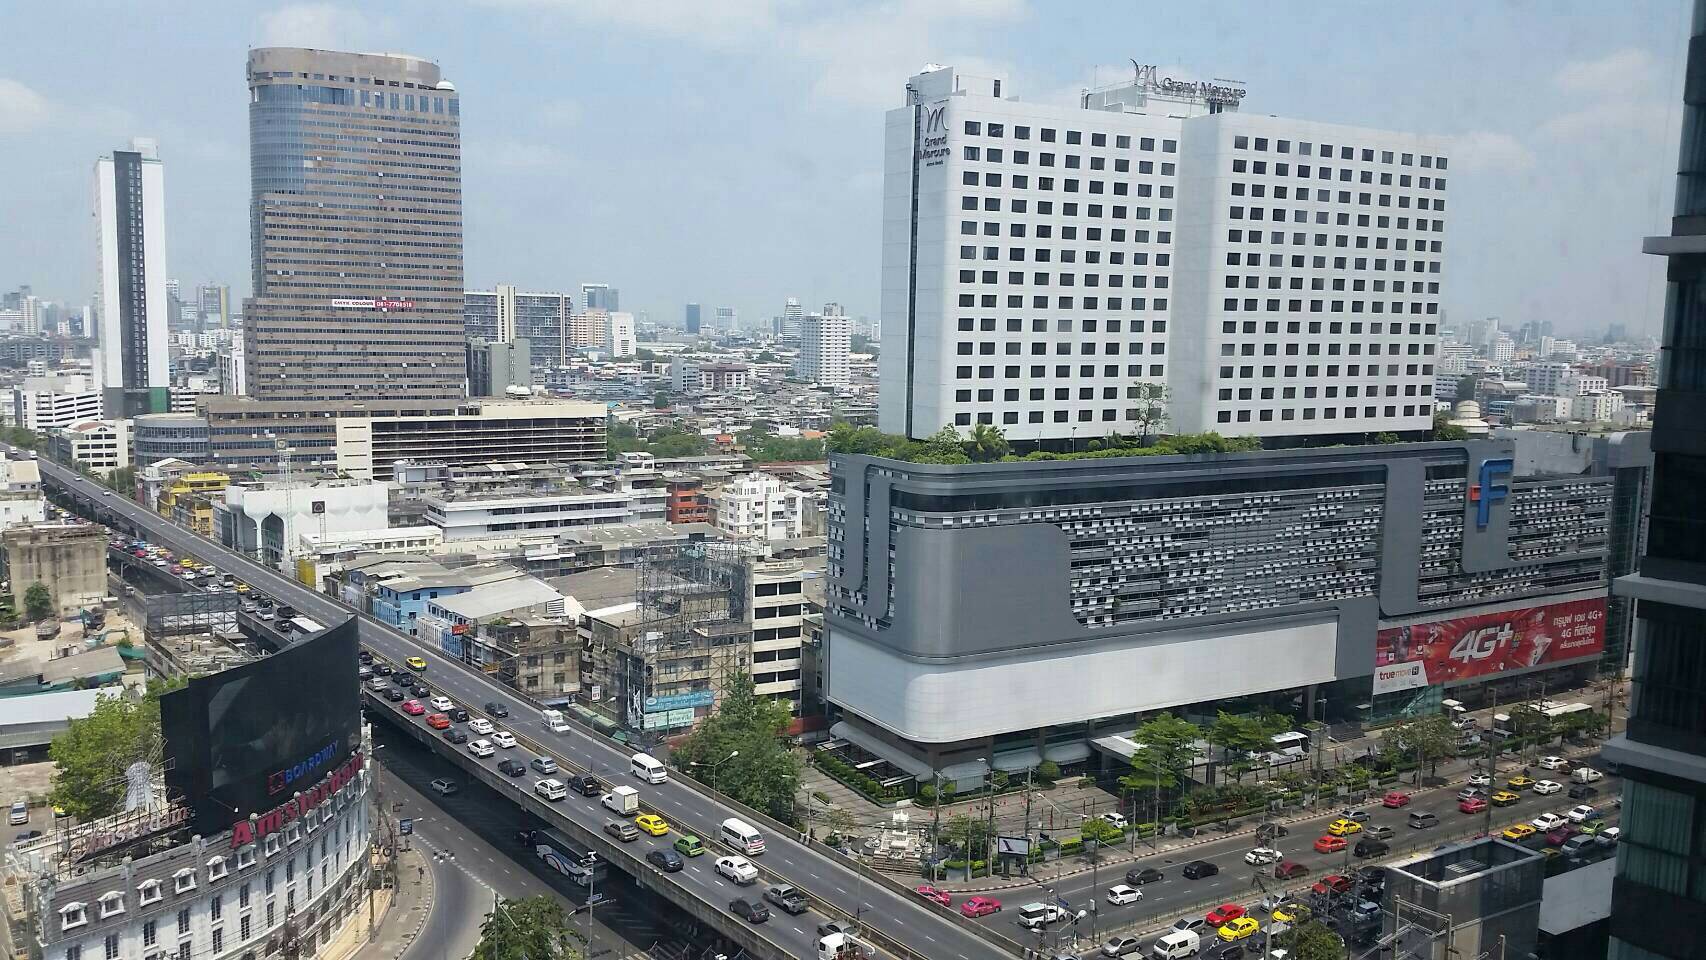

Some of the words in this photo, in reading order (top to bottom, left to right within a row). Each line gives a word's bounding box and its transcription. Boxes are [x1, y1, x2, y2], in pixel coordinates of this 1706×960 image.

[1161, 77, 1198, 94] Grand
[1200, 82, 1246, 98] Mercure
[924, 134, 947, 147] Grand
[920, 147, 951, 160] Mercure
[1587, 610, 1603, 620] 4G+
[1561, 628, 1572, 638] 4G
[1449, 622, 1514, 664] 4G+
